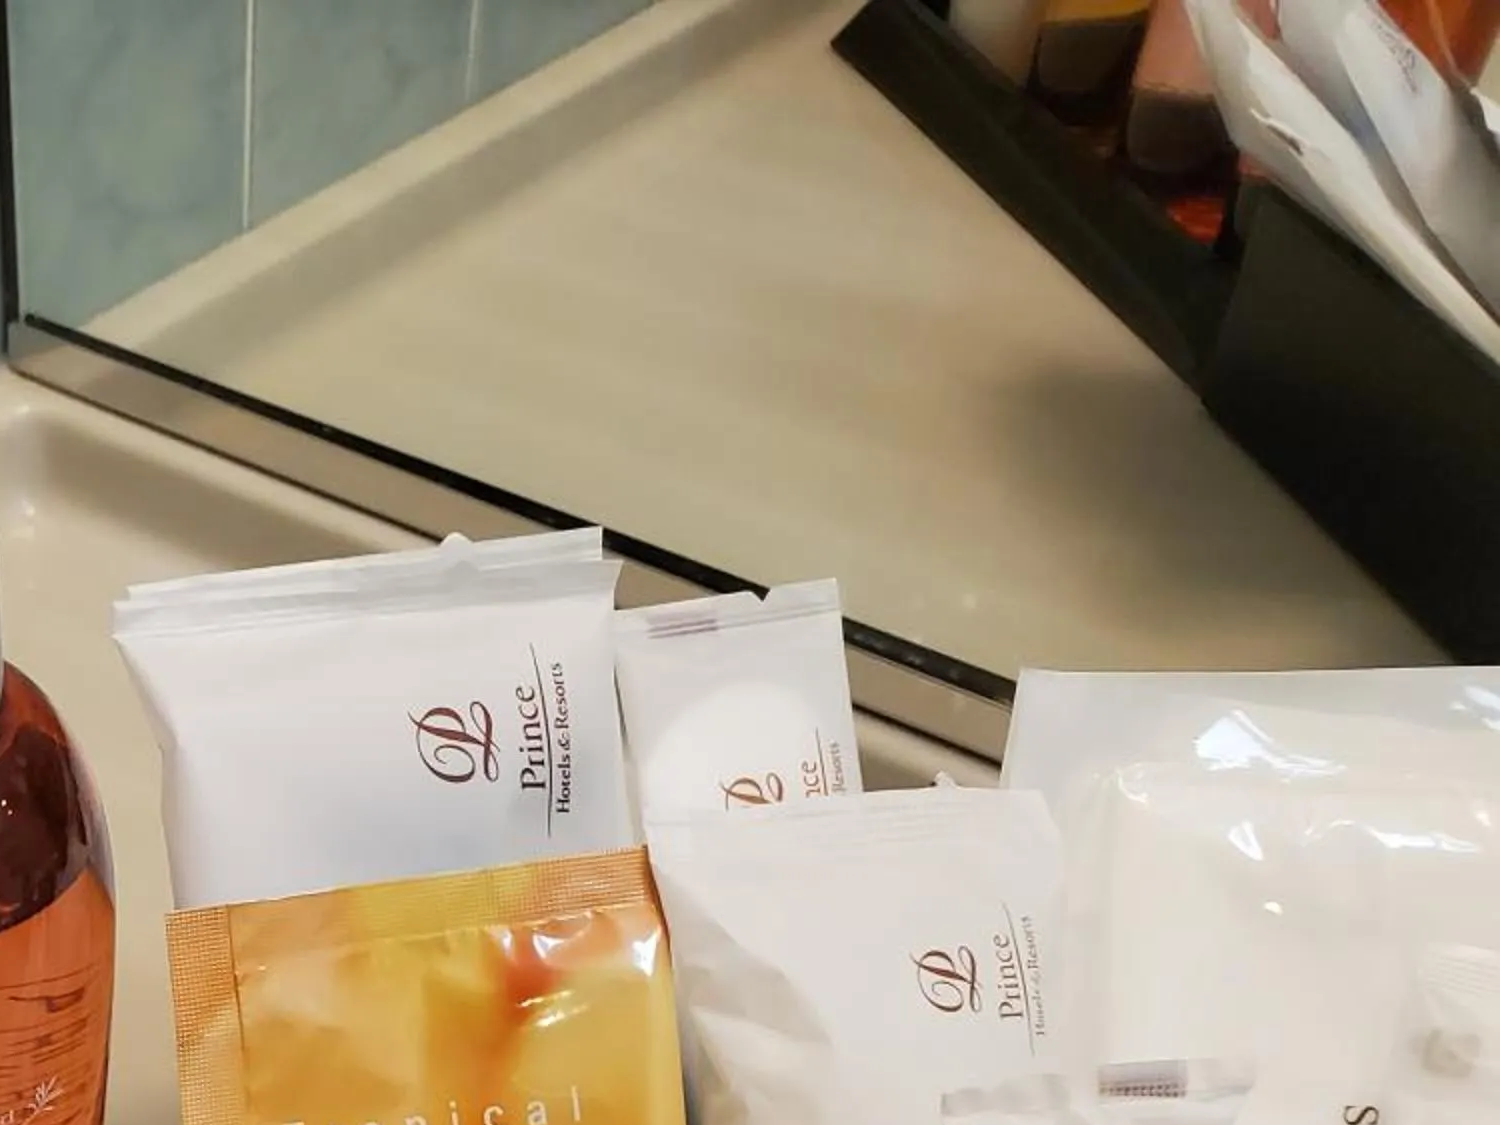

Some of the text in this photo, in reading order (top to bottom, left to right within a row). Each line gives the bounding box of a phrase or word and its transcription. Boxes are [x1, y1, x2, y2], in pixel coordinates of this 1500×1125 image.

[551, 661, 572, 730] Resorts
[514, 685, 547, 791] Prince
[553, 752, 573, 814] Hotels
[801, 759, 821, 798] nce
[992, 934, 1024, 1019] Prince
